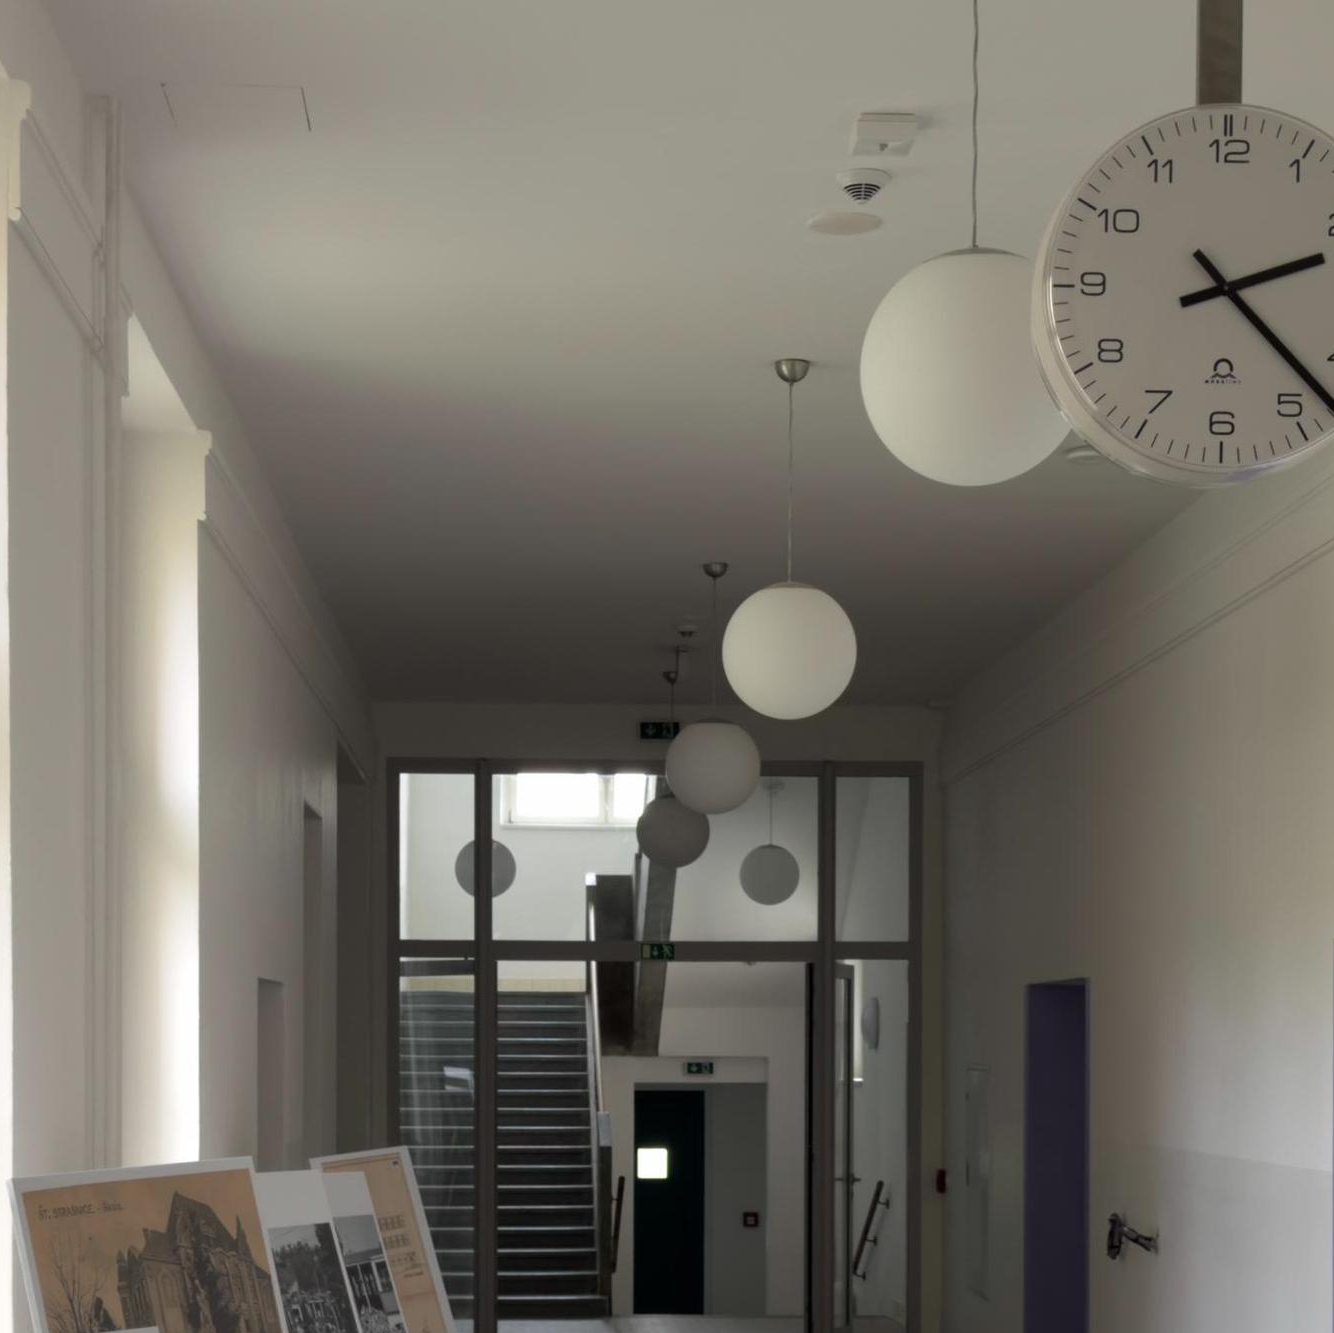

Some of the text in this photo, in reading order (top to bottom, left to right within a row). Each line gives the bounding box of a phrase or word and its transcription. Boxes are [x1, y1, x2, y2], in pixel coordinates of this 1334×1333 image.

[1209, 138, 1250, 164] 12
[1147, 158, 1173, 184] 11
[1289, 158, 1301, 183] 1
[1097, 208, 1140, 234] 10
[1080, 271, 1107, 297] 9
[1097, 338, 1124, 363] 8
[1144, 389, 1173, 414] 7
[1276, 393, 1303, 417] 5
[1209, 410, 1236, 435] 6
